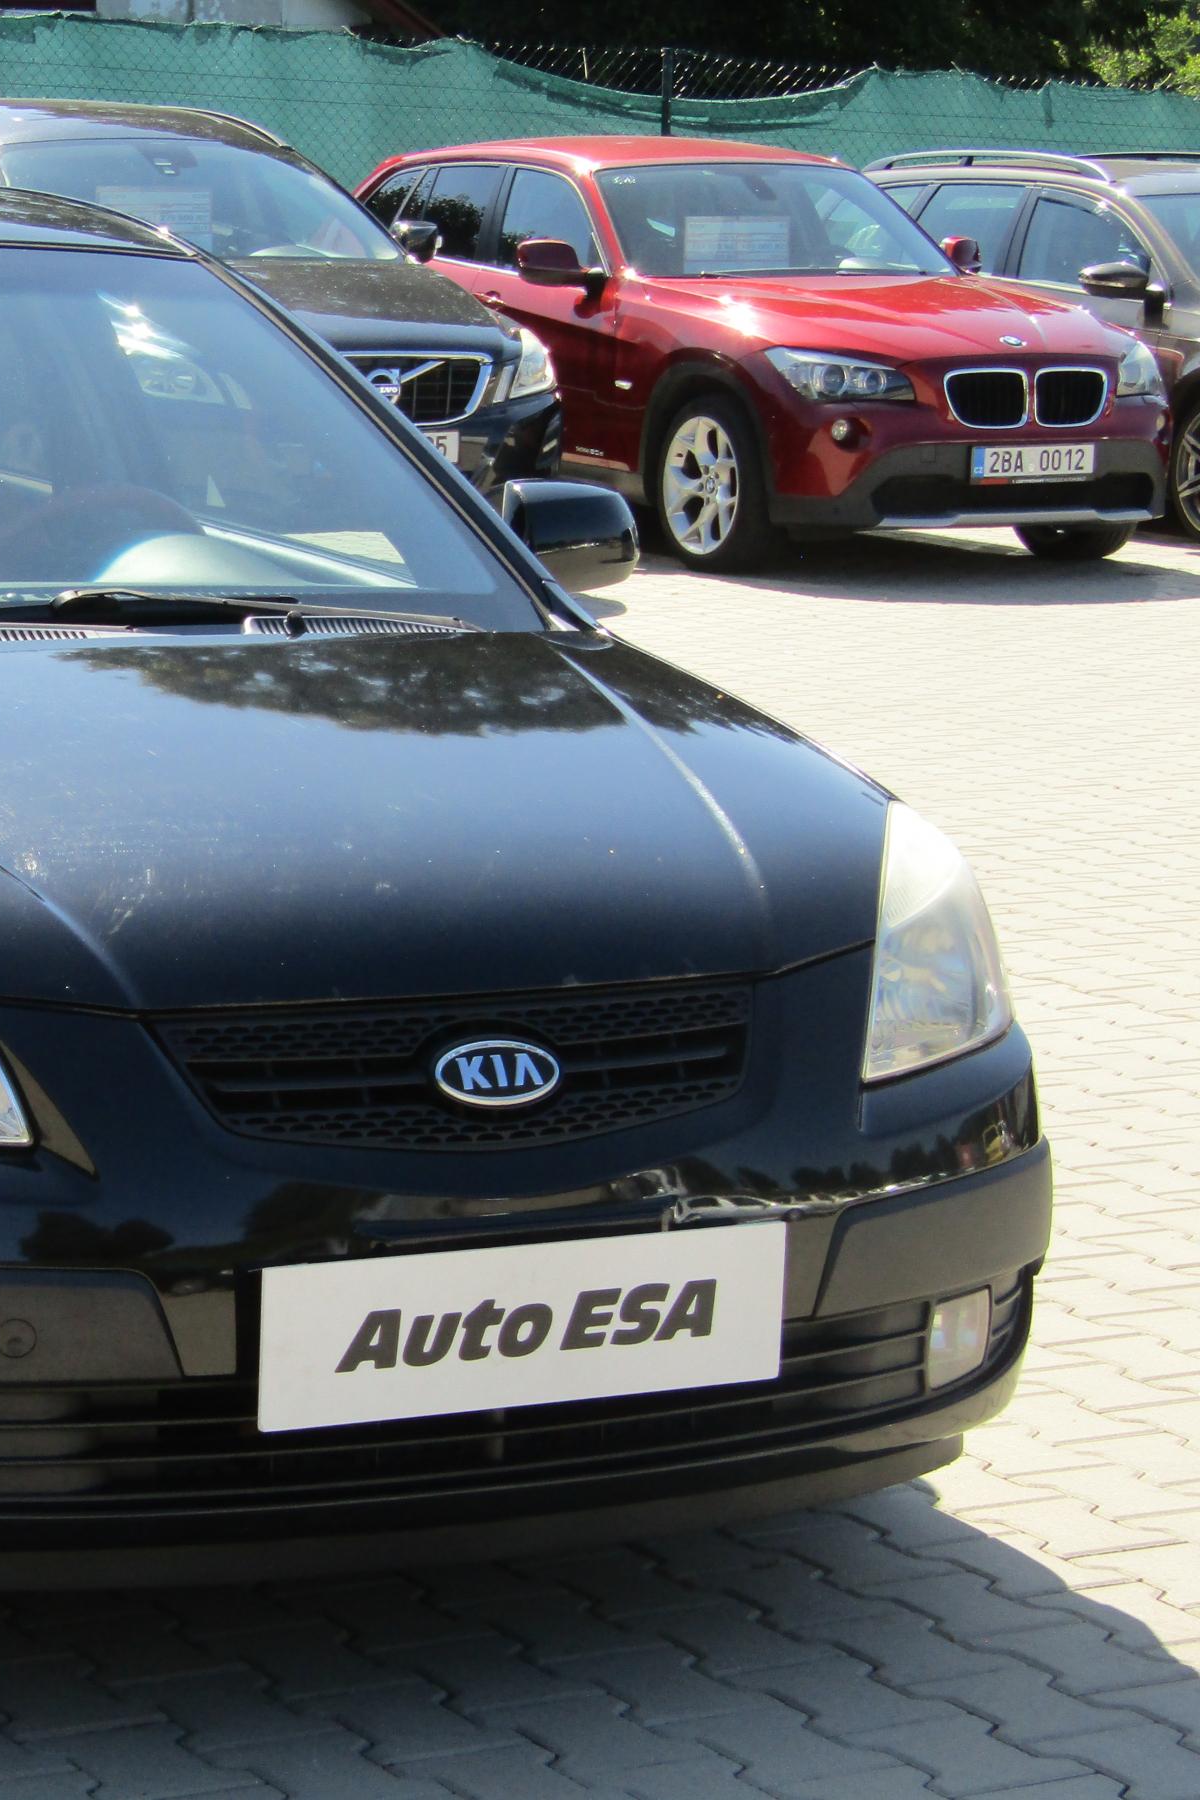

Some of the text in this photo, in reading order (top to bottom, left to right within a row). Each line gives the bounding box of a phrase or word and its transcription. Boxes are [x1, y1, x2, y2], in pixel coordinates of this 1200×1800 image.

[989, 448, 1086, 474] 2BA 0012
[455, 1052, 545, 1091] KIA
[334, 1278, 718, 1374] Auto ESA
